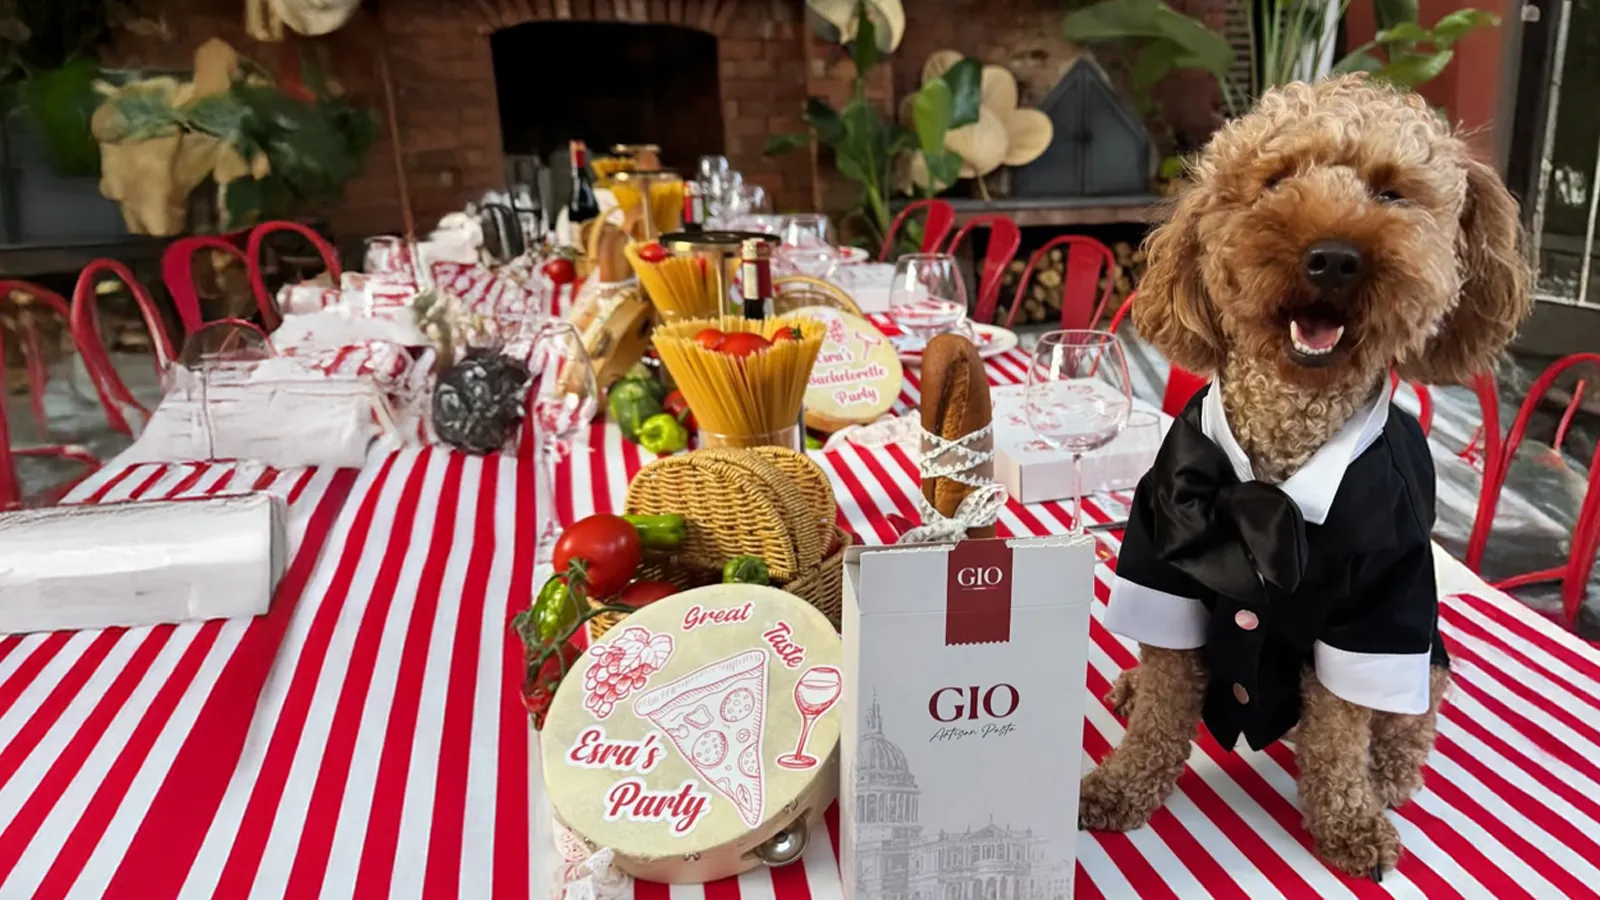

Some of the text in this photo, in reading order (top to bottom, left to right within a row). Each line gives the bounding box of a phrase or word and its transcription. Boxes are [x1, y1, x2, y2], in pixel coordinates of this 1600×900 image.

[817, 348, 852, 363] sra's
[835, 387, 877, 404] Party
[957, 566, 1003, 586] GIO
[682, 602, 806, 668] Great Taste
[928, 683, 1020, 722] GIO
[929, 722, 1016, 742] Artisan Pasta
[570, 730, 659, 769] Esra's
[608, 781, 706, 832] Party
